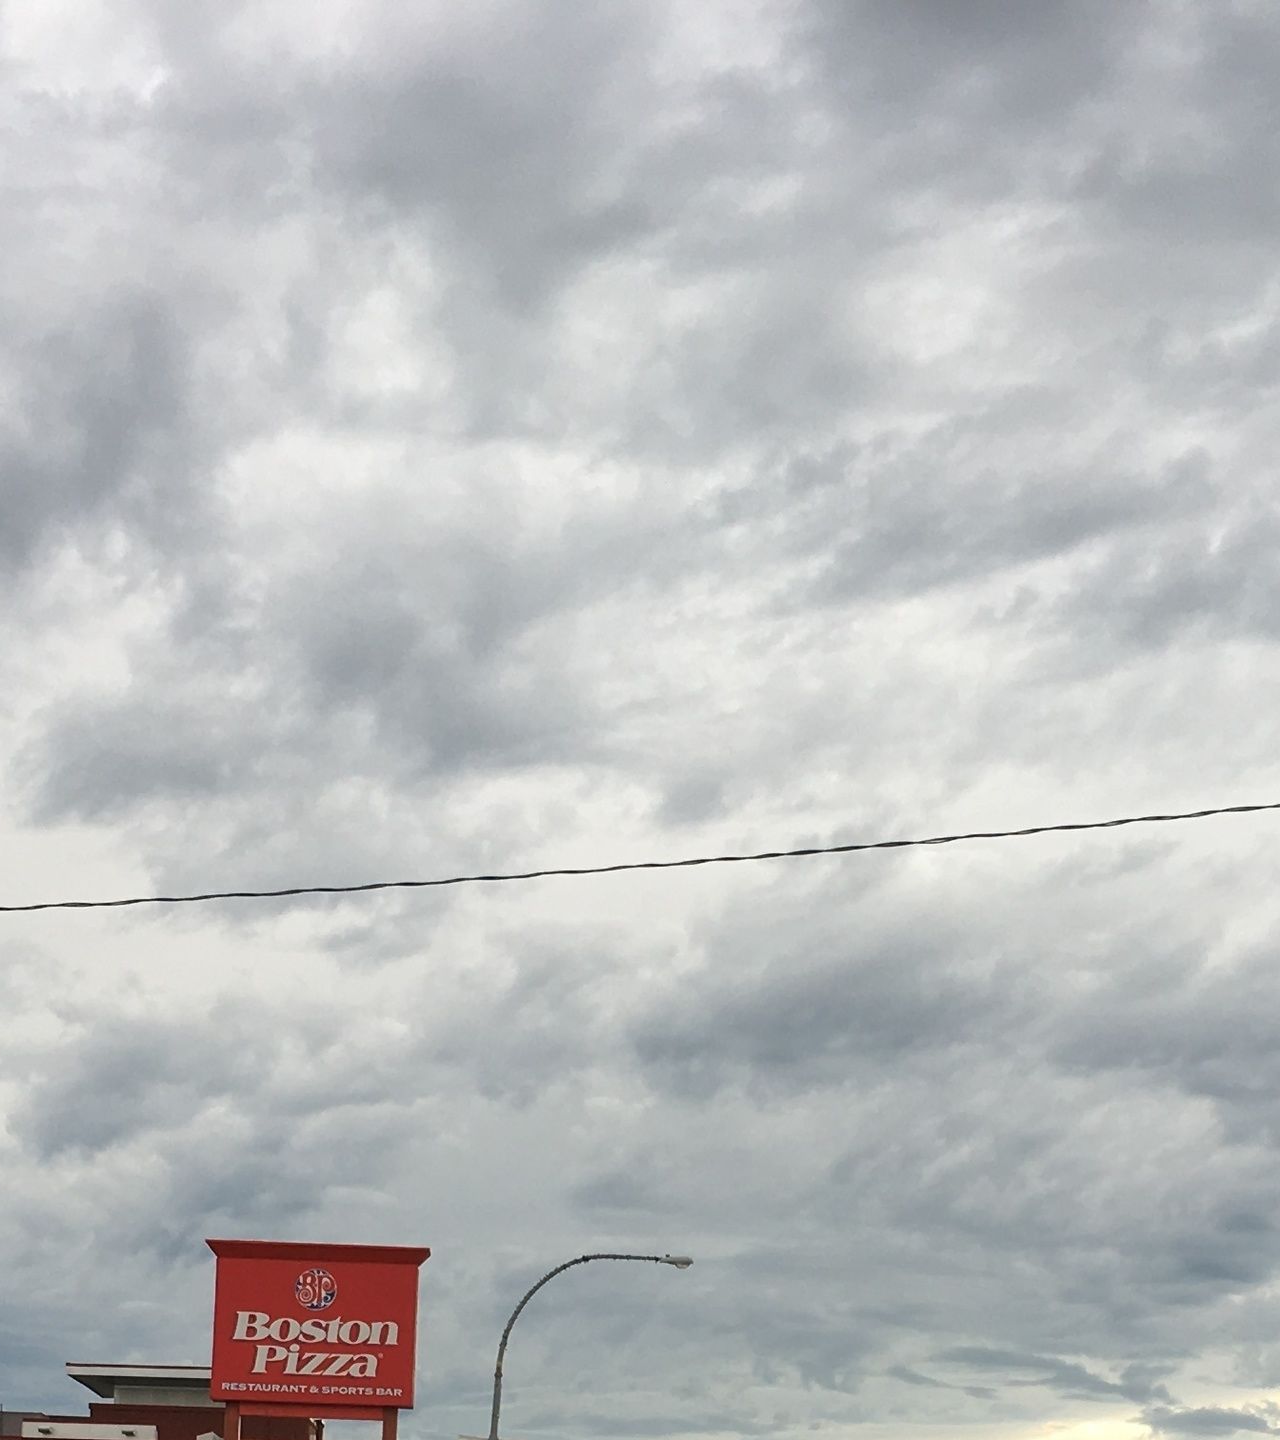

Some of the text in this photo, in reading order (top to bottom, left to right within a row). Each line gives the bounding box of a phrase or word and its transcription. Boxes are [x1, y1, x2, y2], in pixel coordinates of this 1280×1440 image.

[232, 1311, 399, 1345] Boston
[251, 1344, 377, 1377] Pizza
[221, 1382, 403, 1397] RESTAURANT & SPORTS BAR
